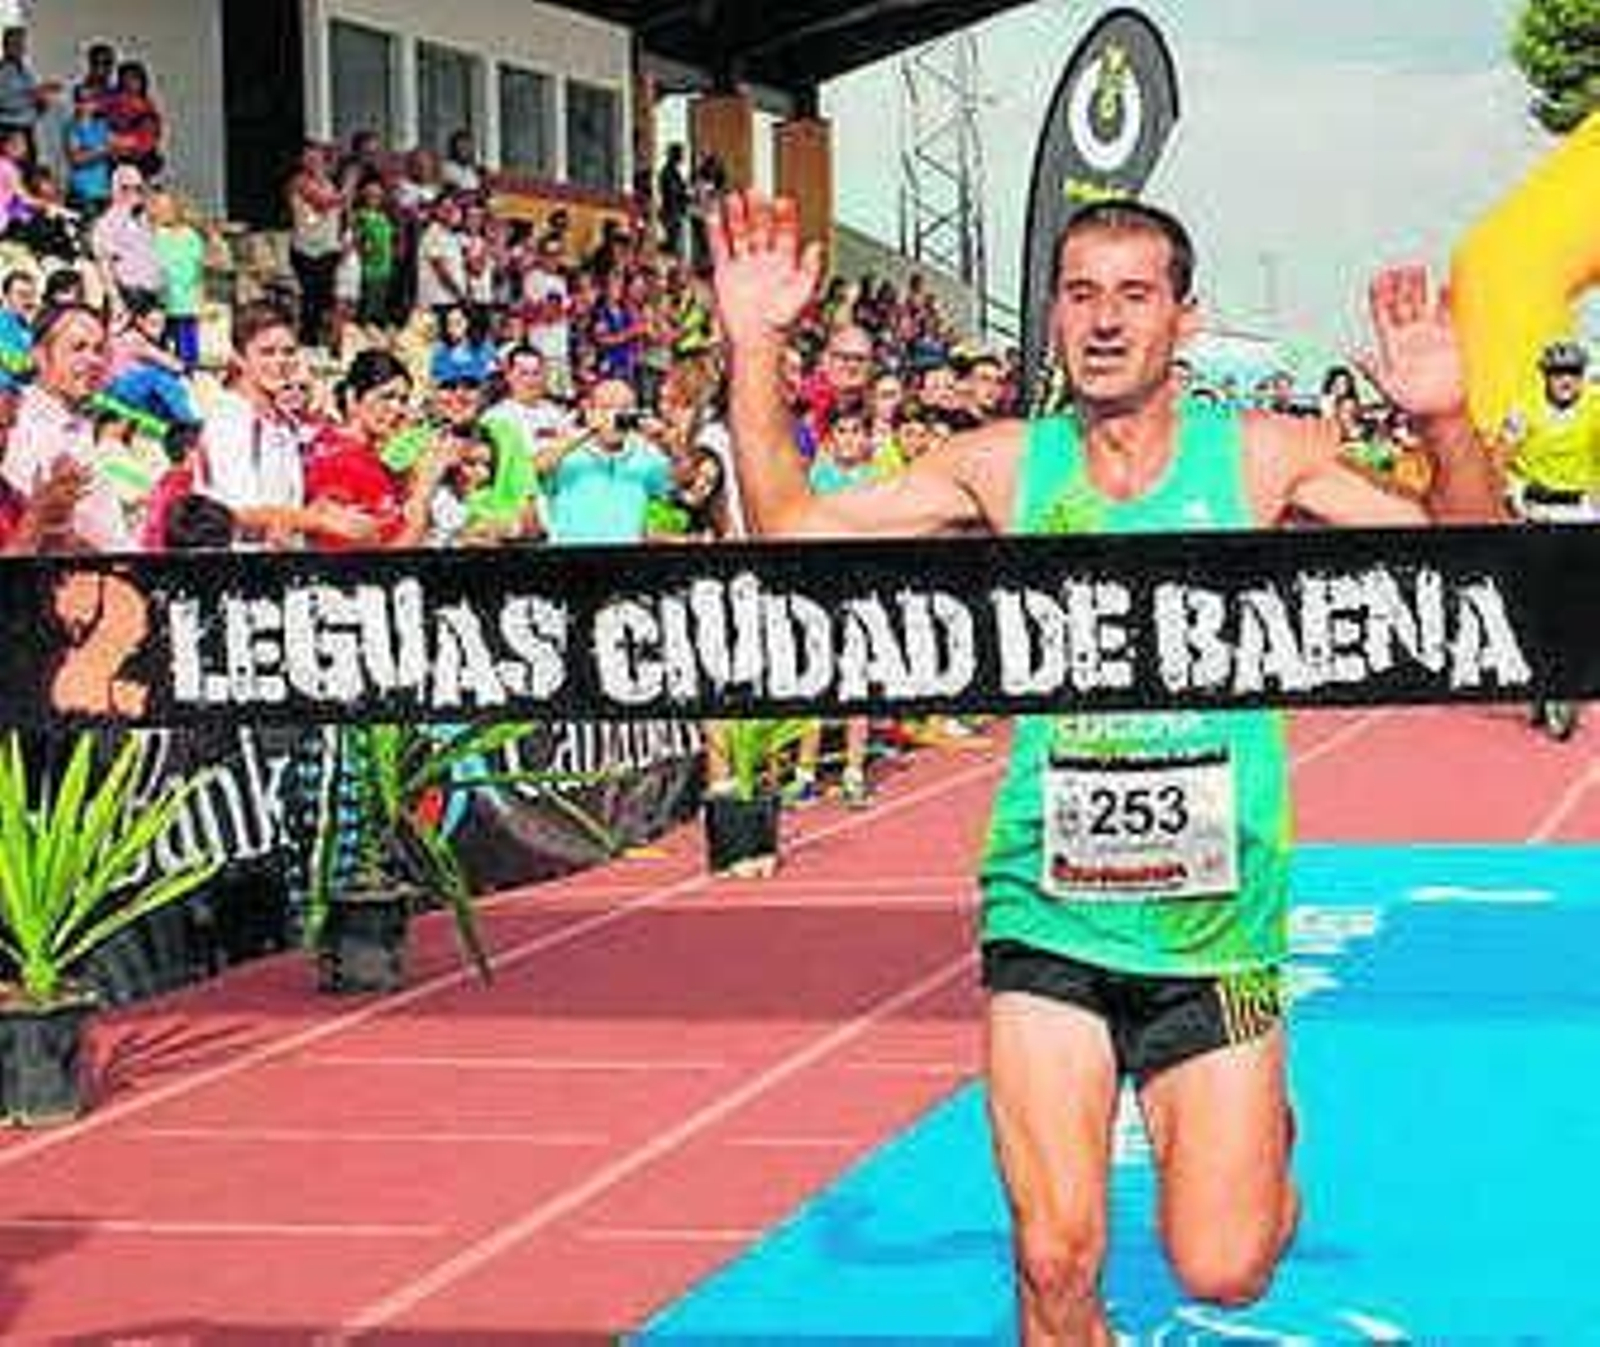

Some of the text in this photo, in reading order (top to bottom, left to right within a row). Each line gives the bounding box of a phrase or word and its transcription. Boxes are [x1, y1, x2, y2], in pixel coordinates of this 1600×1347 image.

[52, 567, 1533, 717] 2 LEGUAS CIUDAD DE BAENA
[1090, 785, 1189, 835] 253
